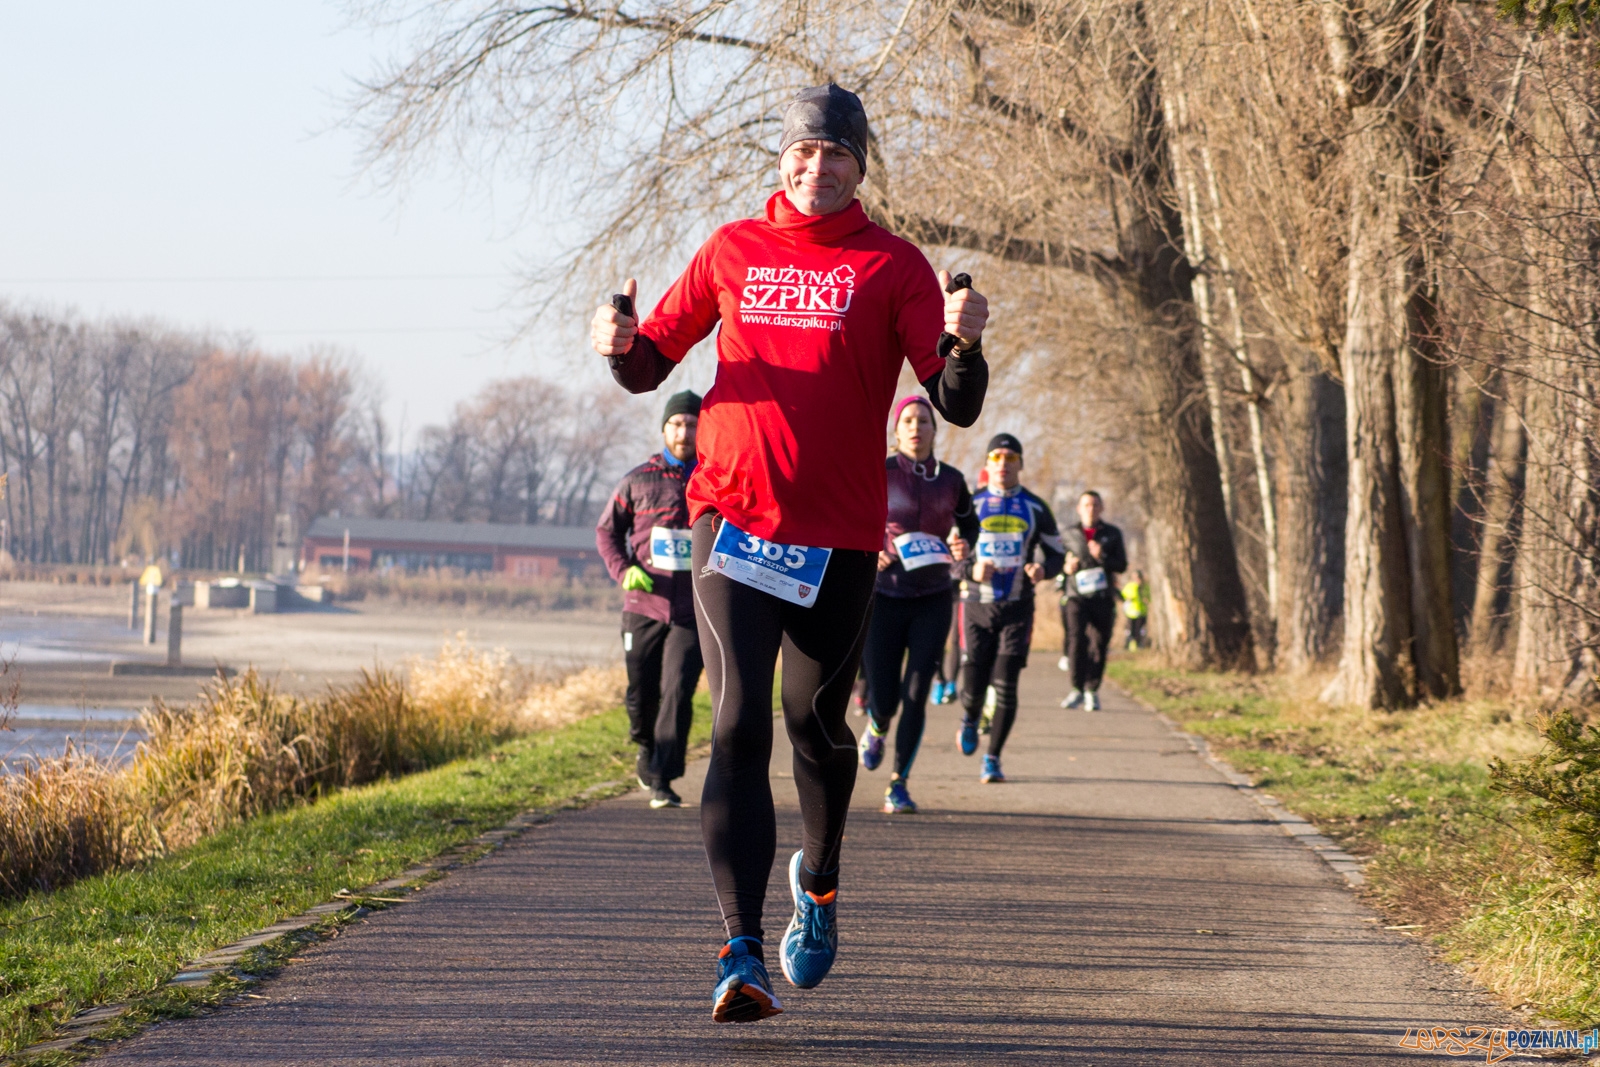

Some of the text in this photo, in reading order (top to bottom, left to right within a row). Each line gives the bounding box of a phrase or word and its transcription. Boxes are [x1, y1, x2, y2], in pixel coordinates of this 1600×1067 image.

[745, 264, 835, 286] DRUŻYNA
[740, 285, 855, 313] SZPIKU
[741, 314, 842, 331] www.darszpiku.pl
[664, 540, 692, 555] 36
[738, 531, 809, 570] 365
[984, 542, 1015, 555] 423
[747, 554, 789, 573] KRZYSZTOF
